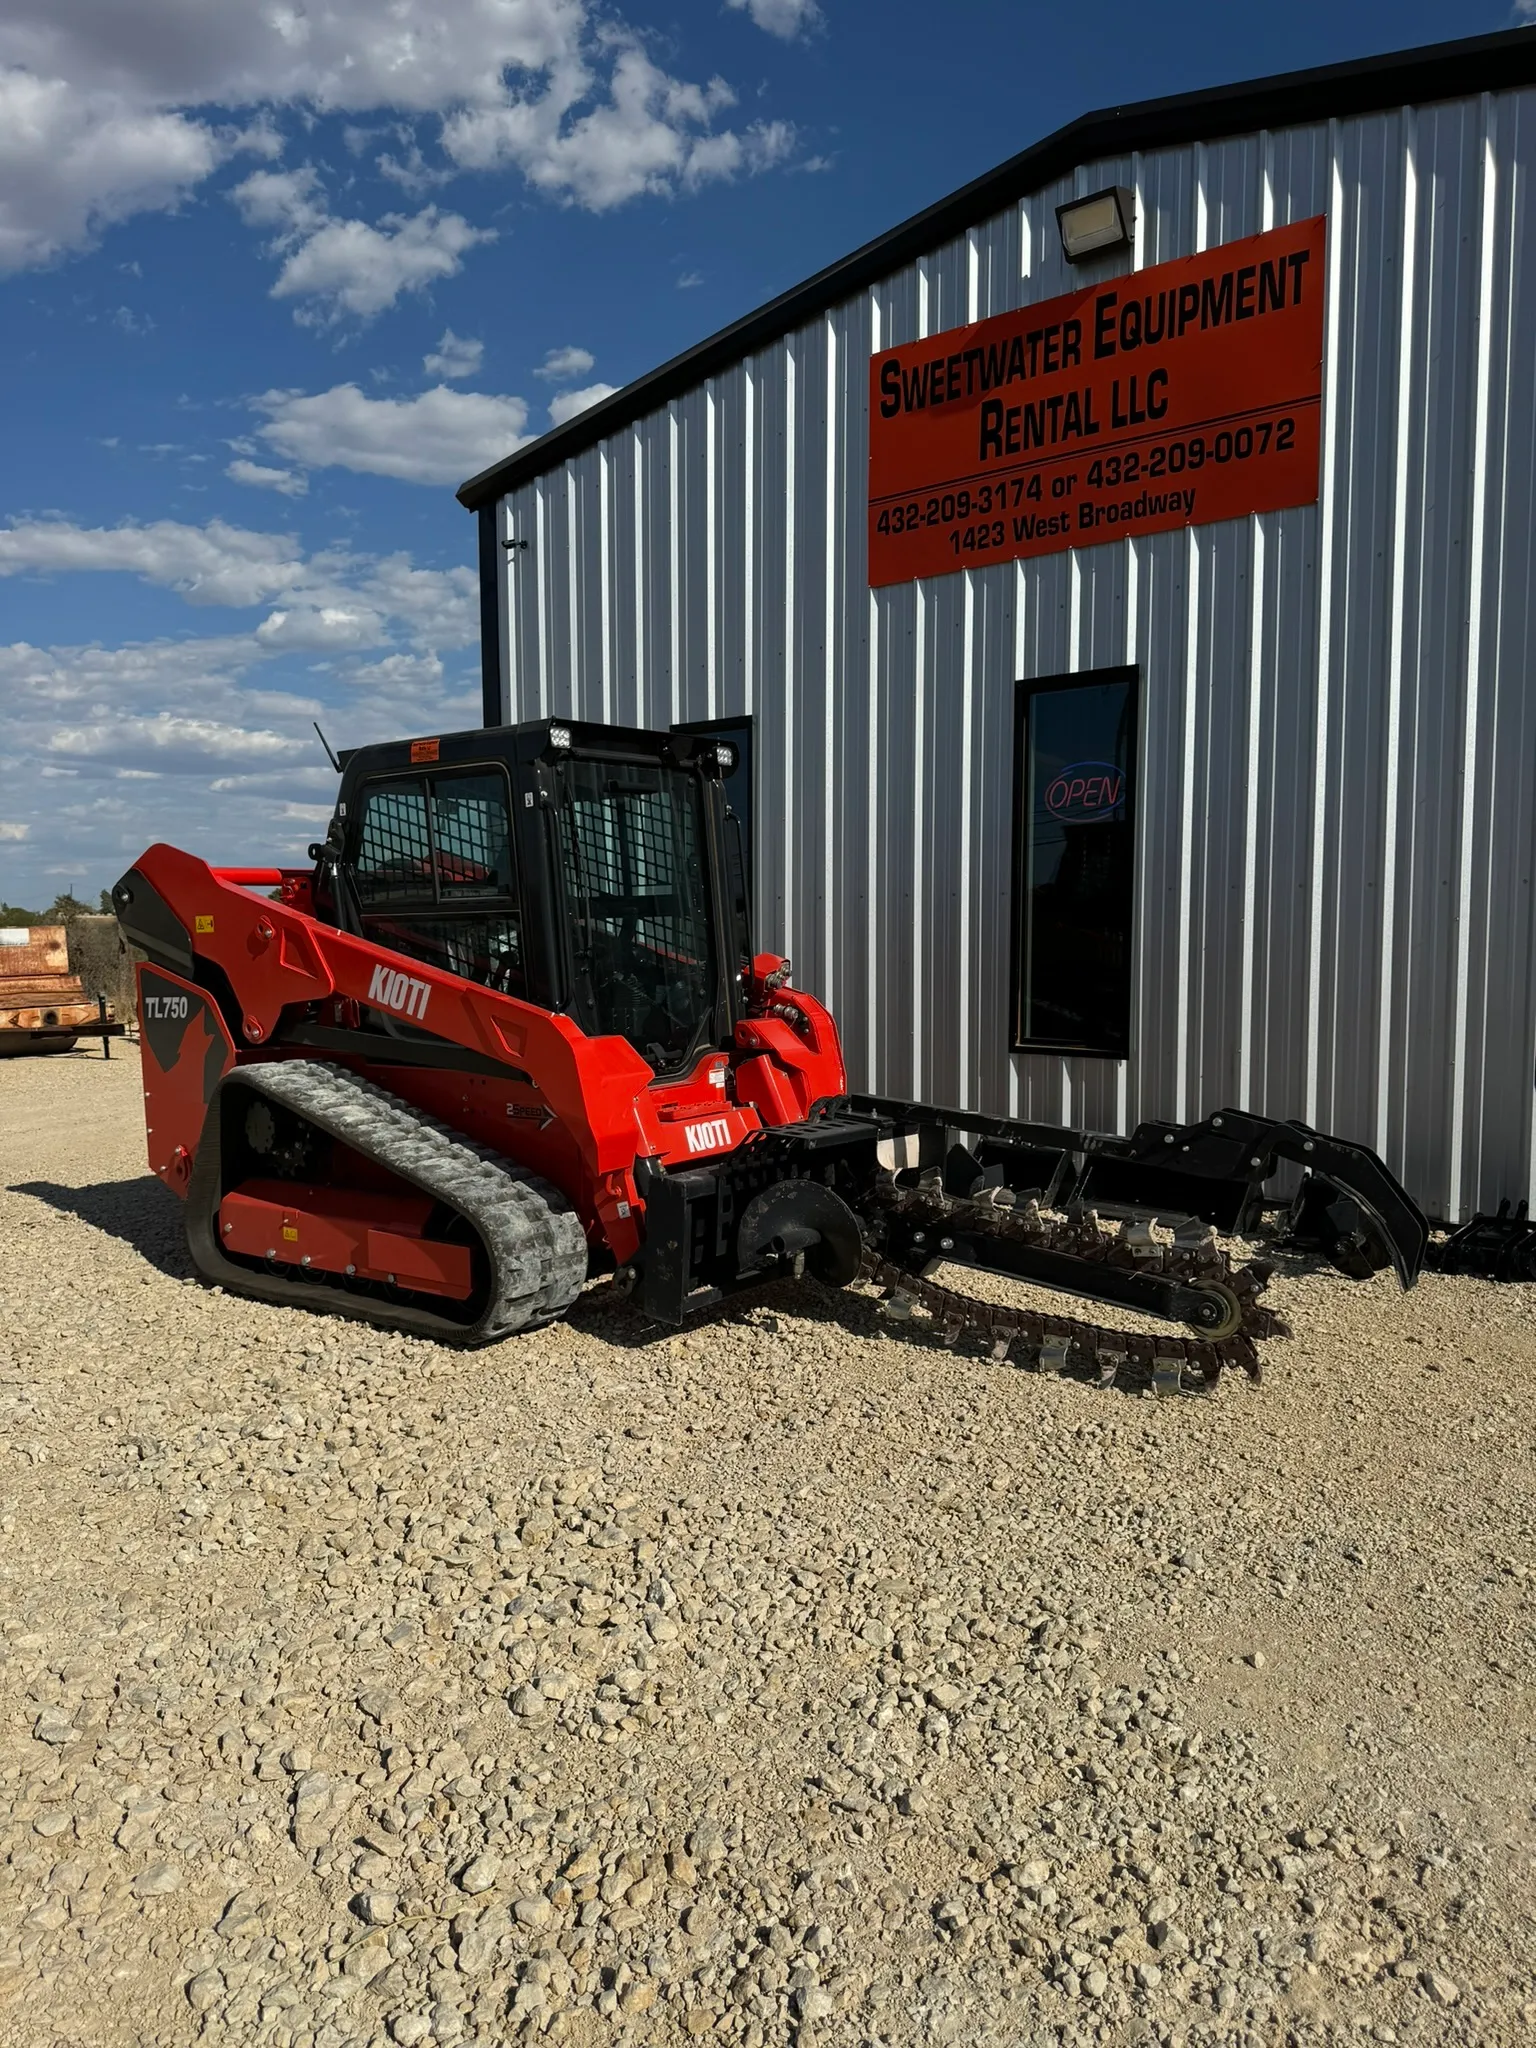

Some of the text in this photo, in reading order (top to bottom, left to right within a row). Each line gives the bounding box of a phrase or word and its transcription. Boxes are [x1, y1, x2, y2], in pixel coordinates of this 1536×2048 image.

[880, 249, 1310, 418] SWEETWATER EQUIPMENT
[979, 368, 1168, 463] RENTAL LLC
[876, 417, 1295, 536] 432-209-3174 or 432-209-0072
[949, 484, 1196, 555] 1423 West Broadway
[1050, 776, 1121, 808] OPEN
[145, 996, 188, 1019] TL750
[368, 963, 432, 1020] KIOTI
[684, 1119, 732, 1153] KIOTI
